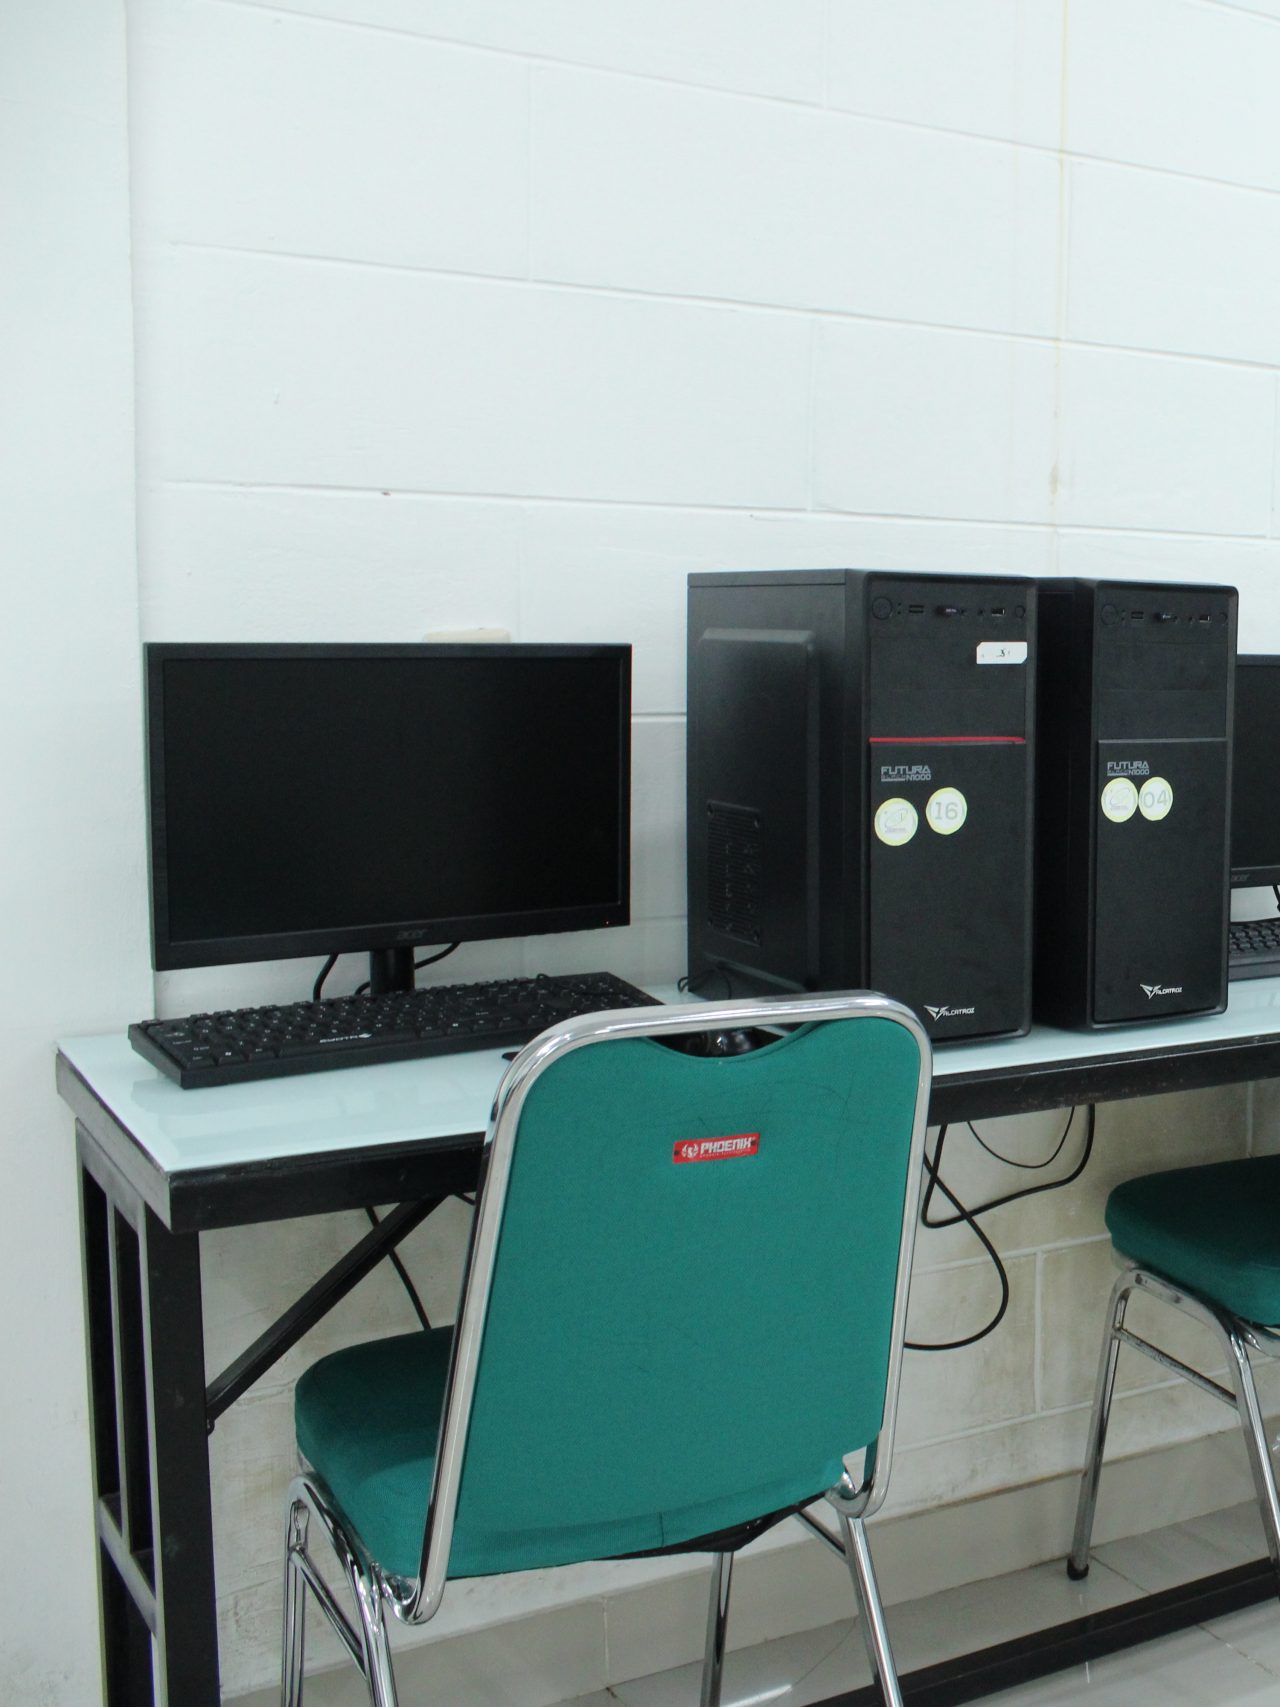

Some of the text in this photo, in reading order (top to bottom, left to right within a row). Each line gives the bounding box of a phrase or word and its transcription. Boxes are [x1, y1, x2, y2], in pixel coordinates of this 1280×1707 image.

[1107, 760, 1149, 769] FUTURA
[881, 765, 931, 774] FUTURA
[1128, 768, 1150, 776] N1000
[905, 773, 932, 781] N1000
[1143, 789, 1168, 808] 04
[935, 801, 958, 820] 16
[700, 1137, 752, 1154] PHOENIX
